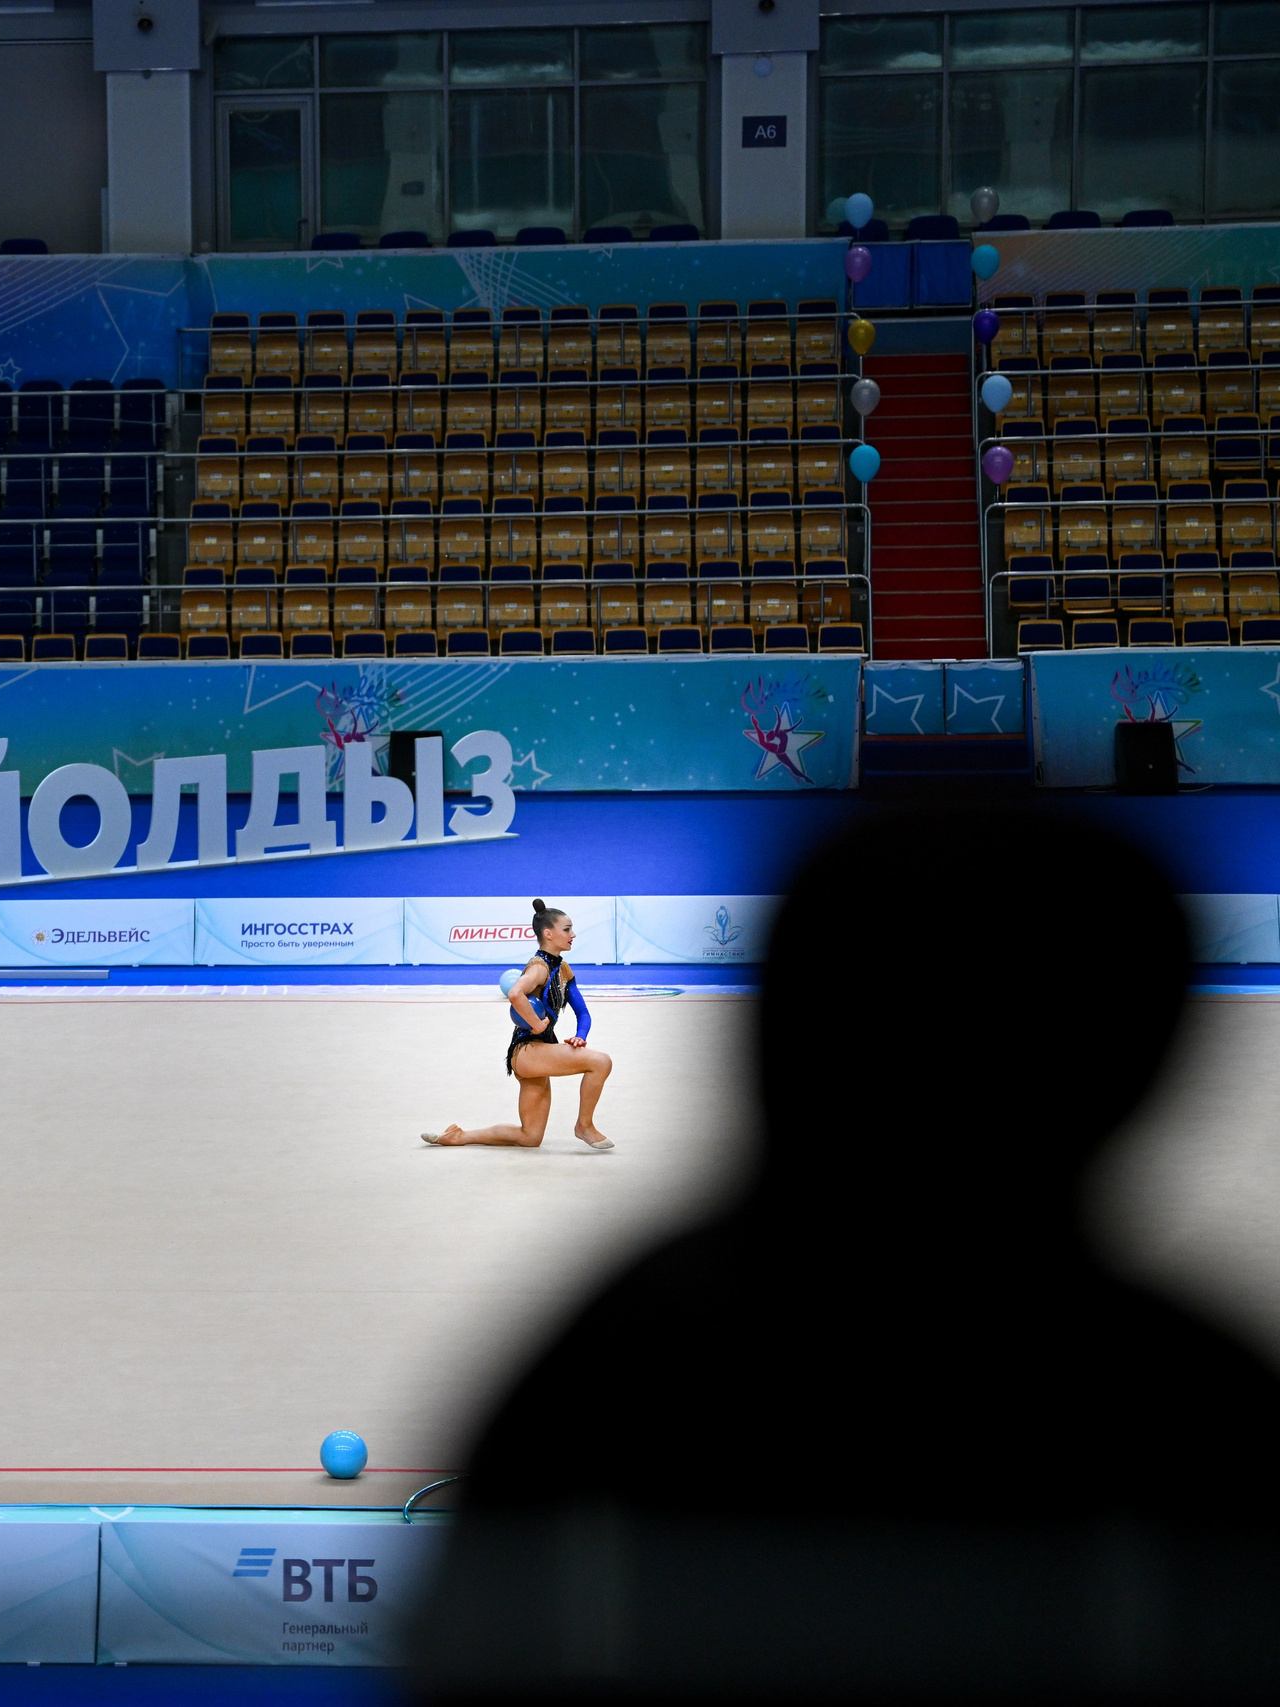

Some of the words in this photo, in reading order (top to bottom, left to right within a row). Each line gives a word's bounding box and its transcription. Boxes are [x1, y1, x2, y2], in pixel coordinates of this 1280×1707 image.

[241, 922, 355, 936] ИНГОССТРАХ
[452, 926, 537, 941] МИНСПО
[240, 939, 276, 949] Просто
[277, 939, 301, 948] быть
[302, 940, 355, 950] уверенным
[282, 1558, 379, 1603] ВТБ
[282, 1621, 369, 1637] Генеральный
[282, 1640, 336, 1655] партнер
